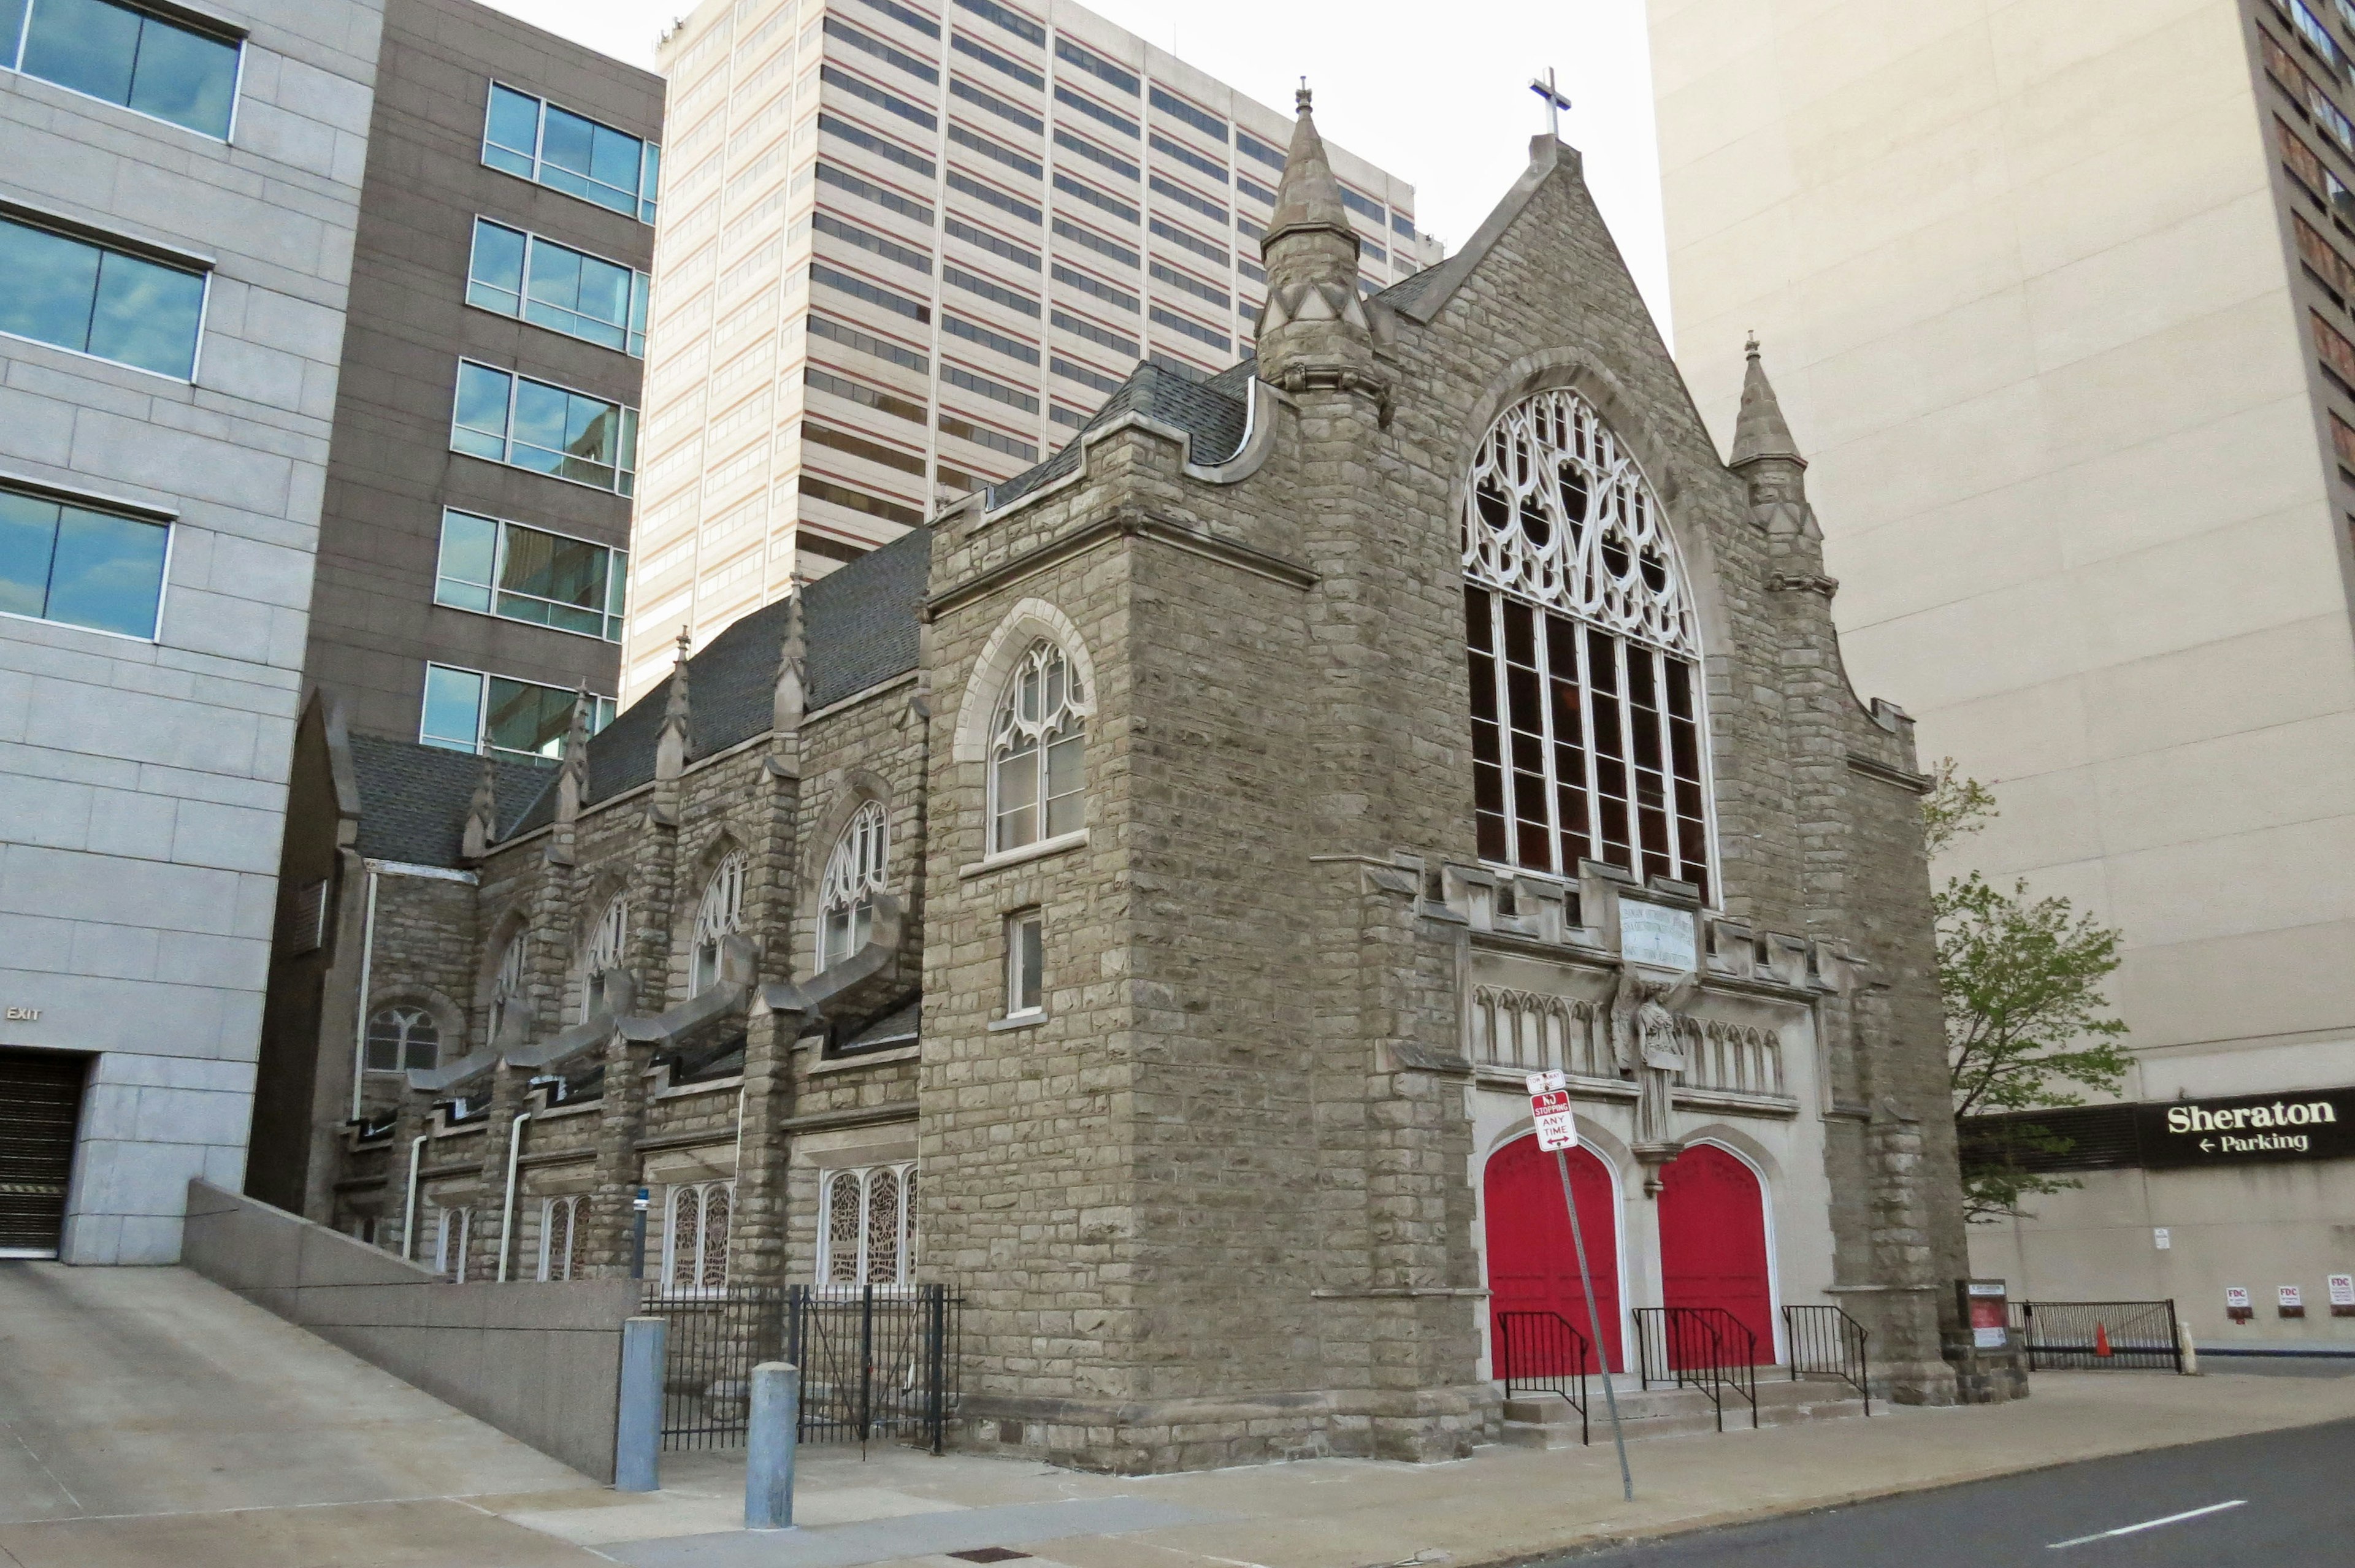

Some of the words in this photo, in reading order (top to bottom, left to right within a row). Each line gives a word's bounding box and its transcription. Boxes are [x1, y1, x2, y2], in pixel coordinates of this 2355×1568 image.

[7, 1007, 42, 1020] EXIT
[1542, 1095, 1556, 1106] NO
[1534, 1103, 1568, 1115] STOPPING
[1543, 1115, 1564, 1126] ANY
[2167, 1101, 2337, 1134] Sheraton
[1544, 1125, 1568, 1136] TIME
[2221, 1133, 2310, 1152] Parking
[2332, 1278, 2349, 1287] FDC
